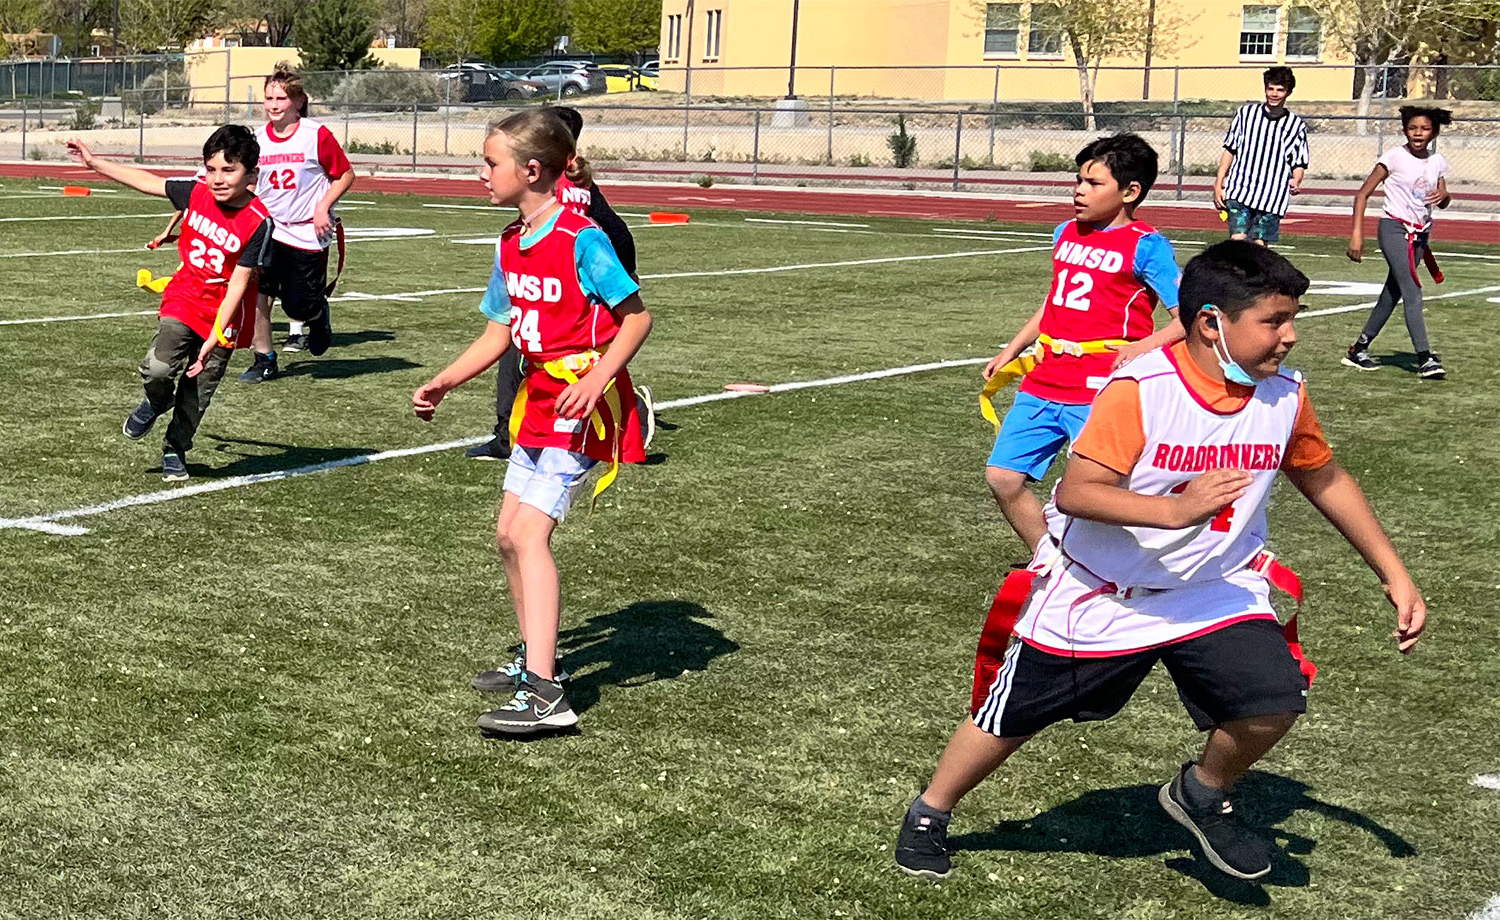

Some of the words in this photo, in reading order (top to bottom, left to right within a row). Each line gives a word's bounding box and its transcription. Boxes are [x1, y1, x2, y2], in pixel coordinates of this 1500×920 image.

[269, 169, 296, 189] 42
[188, 210, 241, 253] NMSD
[189, 238, 225, 274] 23
[1054, 241, 1124, 273] NMSD
[1052, 269, 1094, 312] 12
[510, 306, 543, 352] 24
